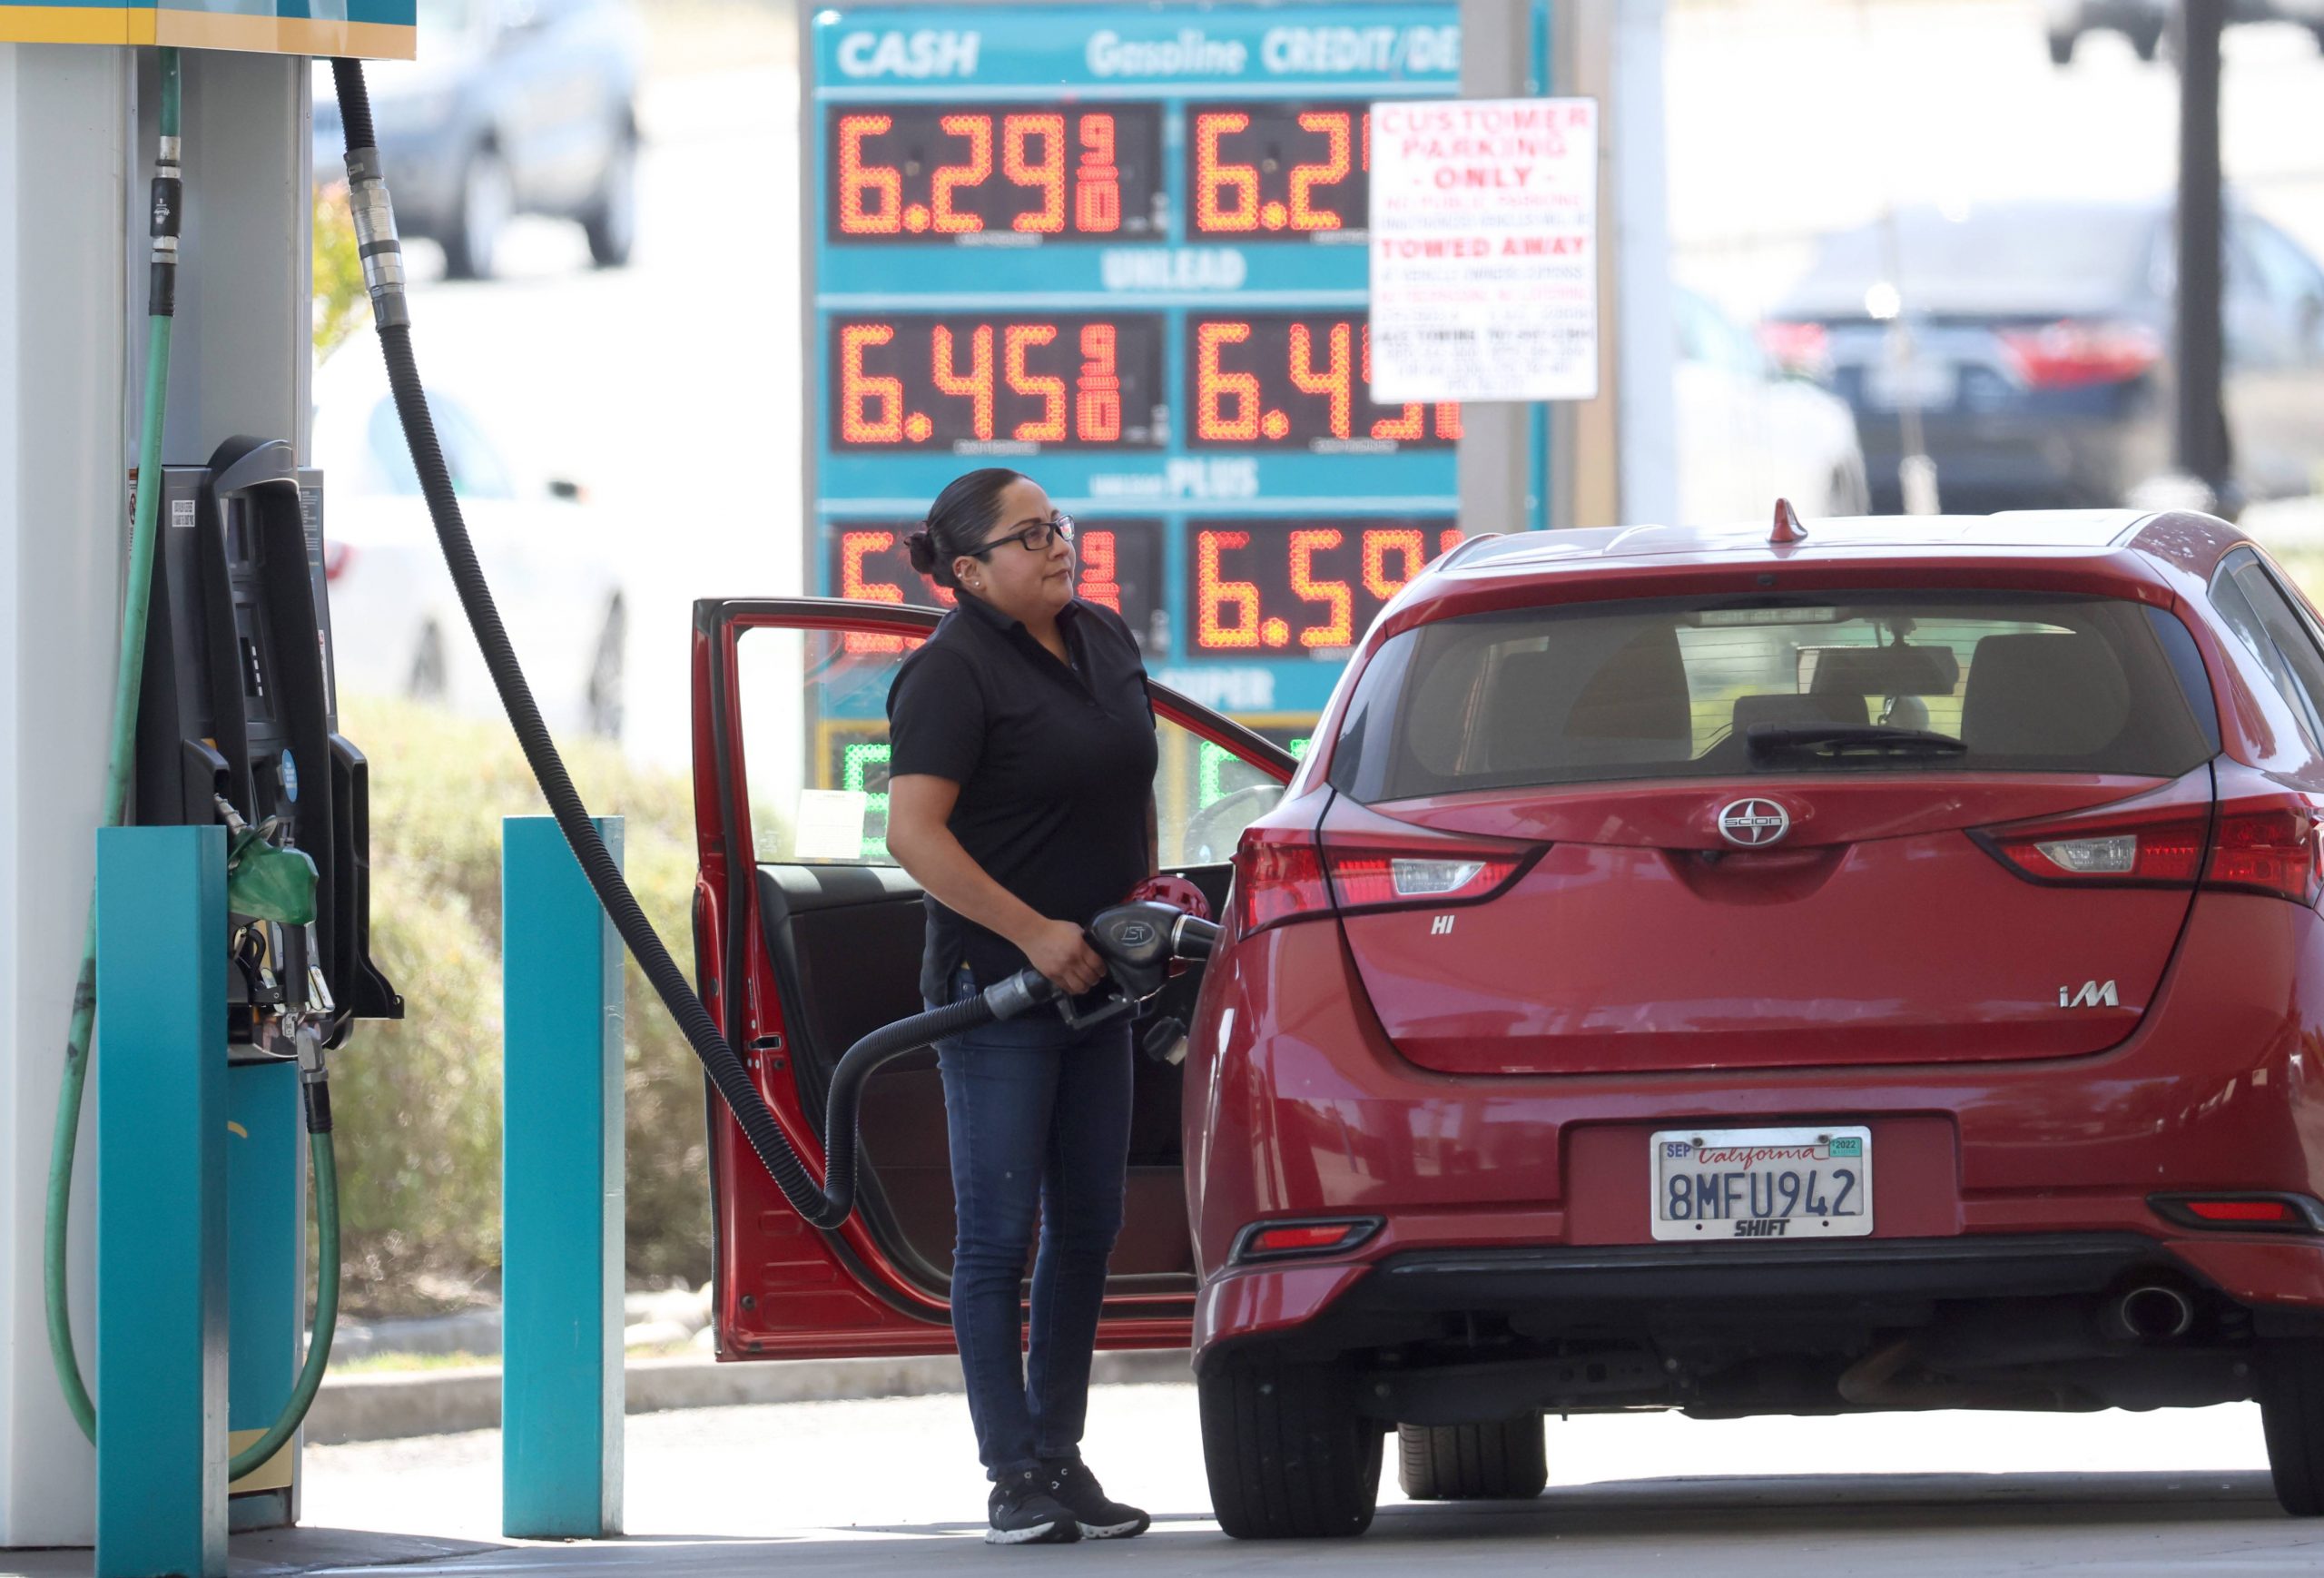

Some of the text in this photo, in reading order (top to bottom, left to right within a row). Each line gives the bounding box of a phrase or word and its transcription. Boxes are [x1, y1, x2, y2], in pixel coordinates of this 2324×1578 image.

[837, 30, 981, 77] CASH
[1086, 28, 1248, 75] Gasoline
[1382, 106, 1589, 133] CUSTOMER
[1401, 135, 1568, 160] PARKING
[839, 113, 1066, 234] 6.29
[1196, 112, 1370, 232] 6.2
[1434, 167, 1532, 189] ONLY
[1381, 237, 1492, 260] TOWED
[1502, 235, 1586, 257] AWAY
[1100, 249, 1247, 291] UNLEAD
[842, 323, 1067, 443] 6.45
[1167, 459, 1258, 499] PLUS
[1725, 817, 1783, 826] SCION
[1667, 1143, 1692, 1158] SEP
[1836, 1140, 1856, 1149] 2022
[1699, 1148, 1830, 1171] California
[1669, 1169, 1856, 1220] 8MFU942
[1734, 1218, 1791, 1238] SHIFT
